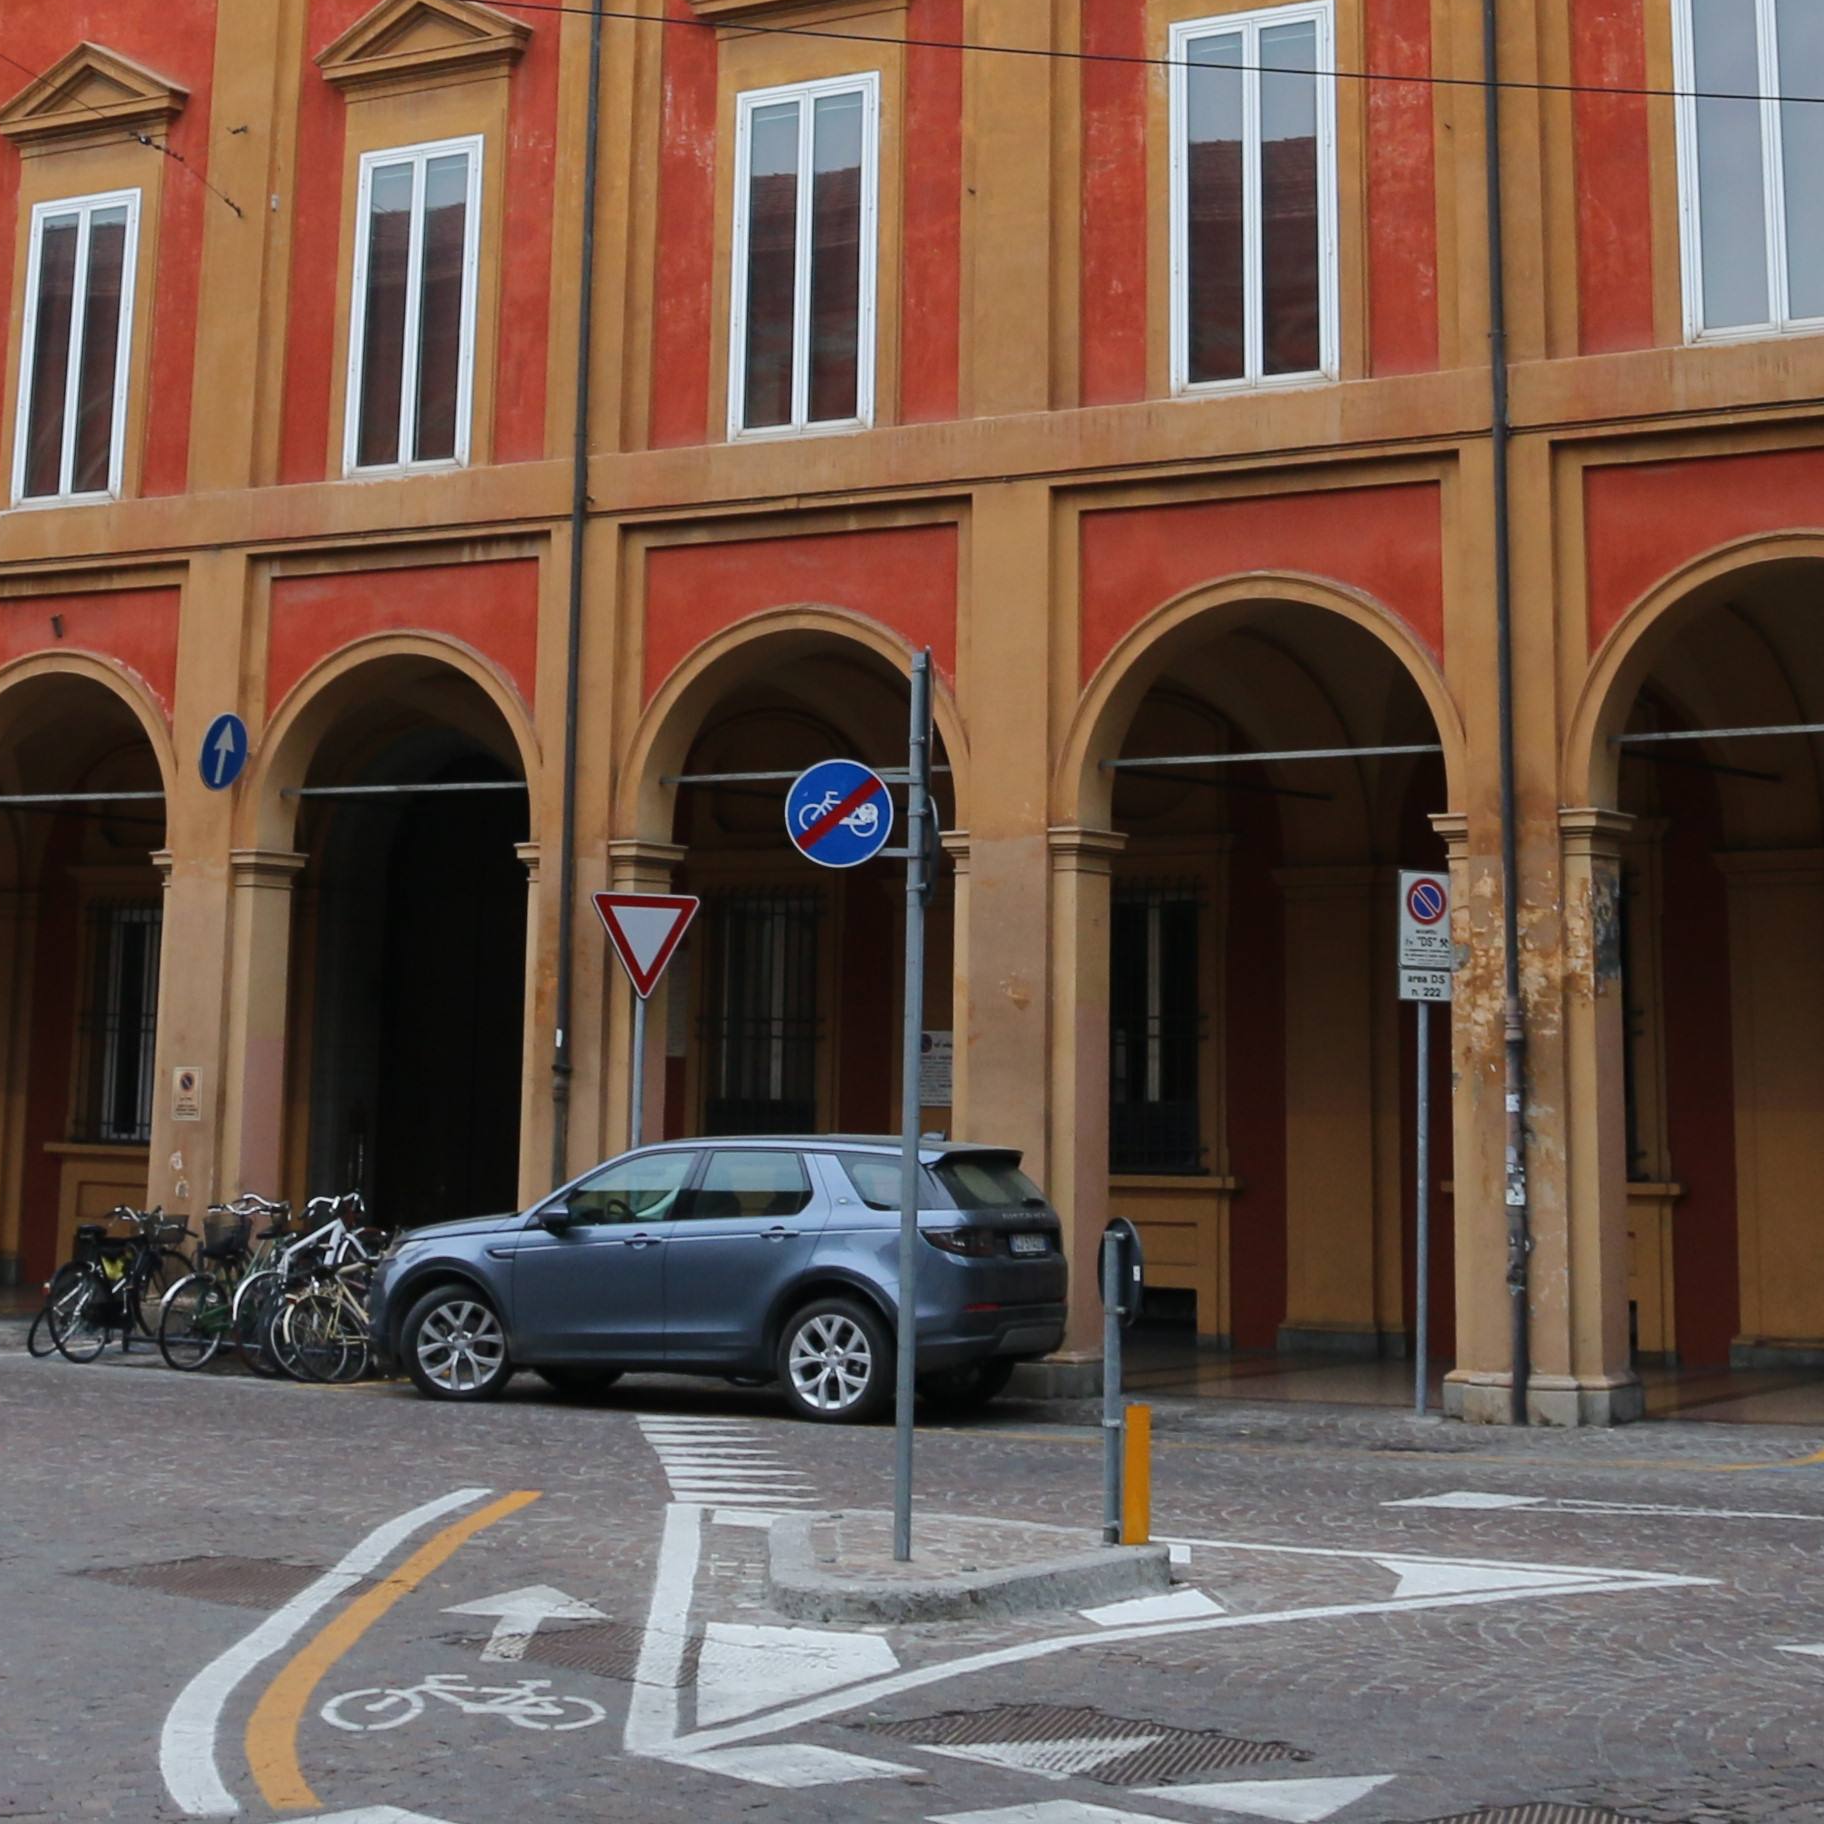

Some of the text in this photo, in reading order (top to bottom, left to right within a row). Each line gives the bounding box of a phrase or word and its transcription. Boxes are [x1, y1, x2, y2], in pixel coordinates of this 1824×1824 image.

[1408, 974, 1446, 984] area DS
[1423, 987, 1441, 997] 222
